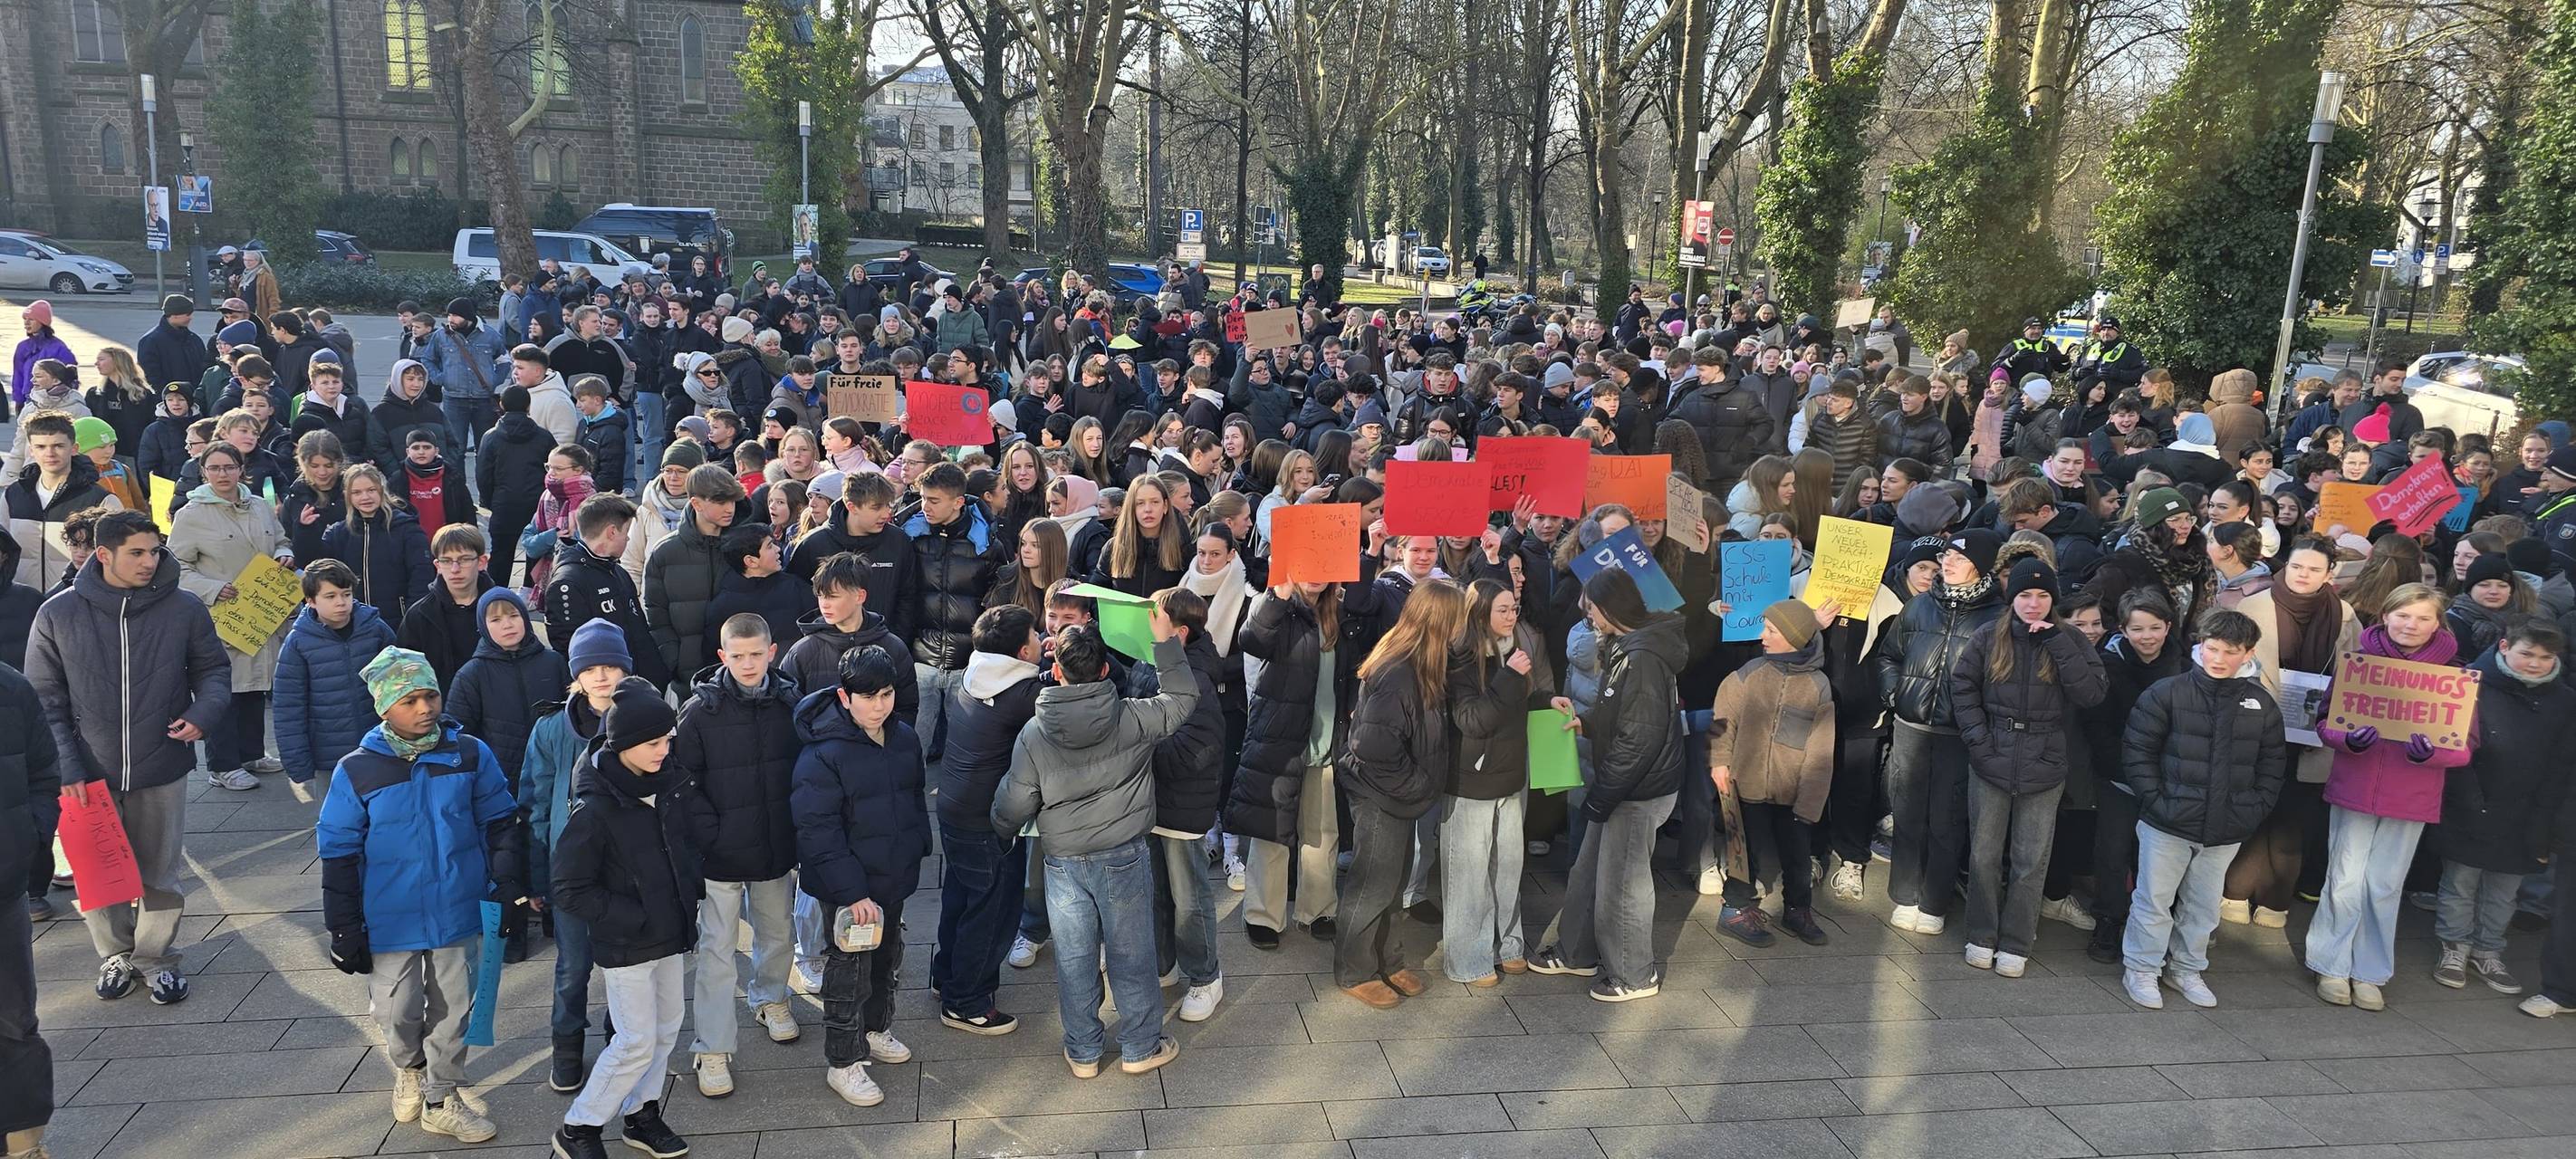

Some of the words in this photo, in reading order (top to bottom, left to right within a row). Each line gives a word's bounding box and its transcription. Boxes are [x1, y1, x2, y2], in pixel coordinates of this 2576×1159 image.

[1185, 212, 1197, 229] P
[2437, 245, 2446, 257] P
[830, 377, 851, 388] Für
[853, 377, 882, 388] freie
[829, 391, 890, 414] DEMOKRATIE
[911, 391, 960, 413] MORE
[1613, 458, 1638, 478] JA
[2376, 461, 2443, 512] Demokratie
[2398, 483, 2444, 521] erhalten
[1827, 522, 1864, 538] UNSER
[1831, 534, 1868, 549] NEUES
[1624, 543, 1648, 568] FÜR
[1725, 544, 1766, 565] CSG
[1724, 565, 1772, 589] Schule
[1822, 568, 1880, 589] DEMOKRATIE
[601, 599, 617, 613] CK
[1725, 589, 1754, 603] mit
[2344, 660, 2472, 700] MEINUNGS
[2342, 691, 2463, 725] FREIHEIT
